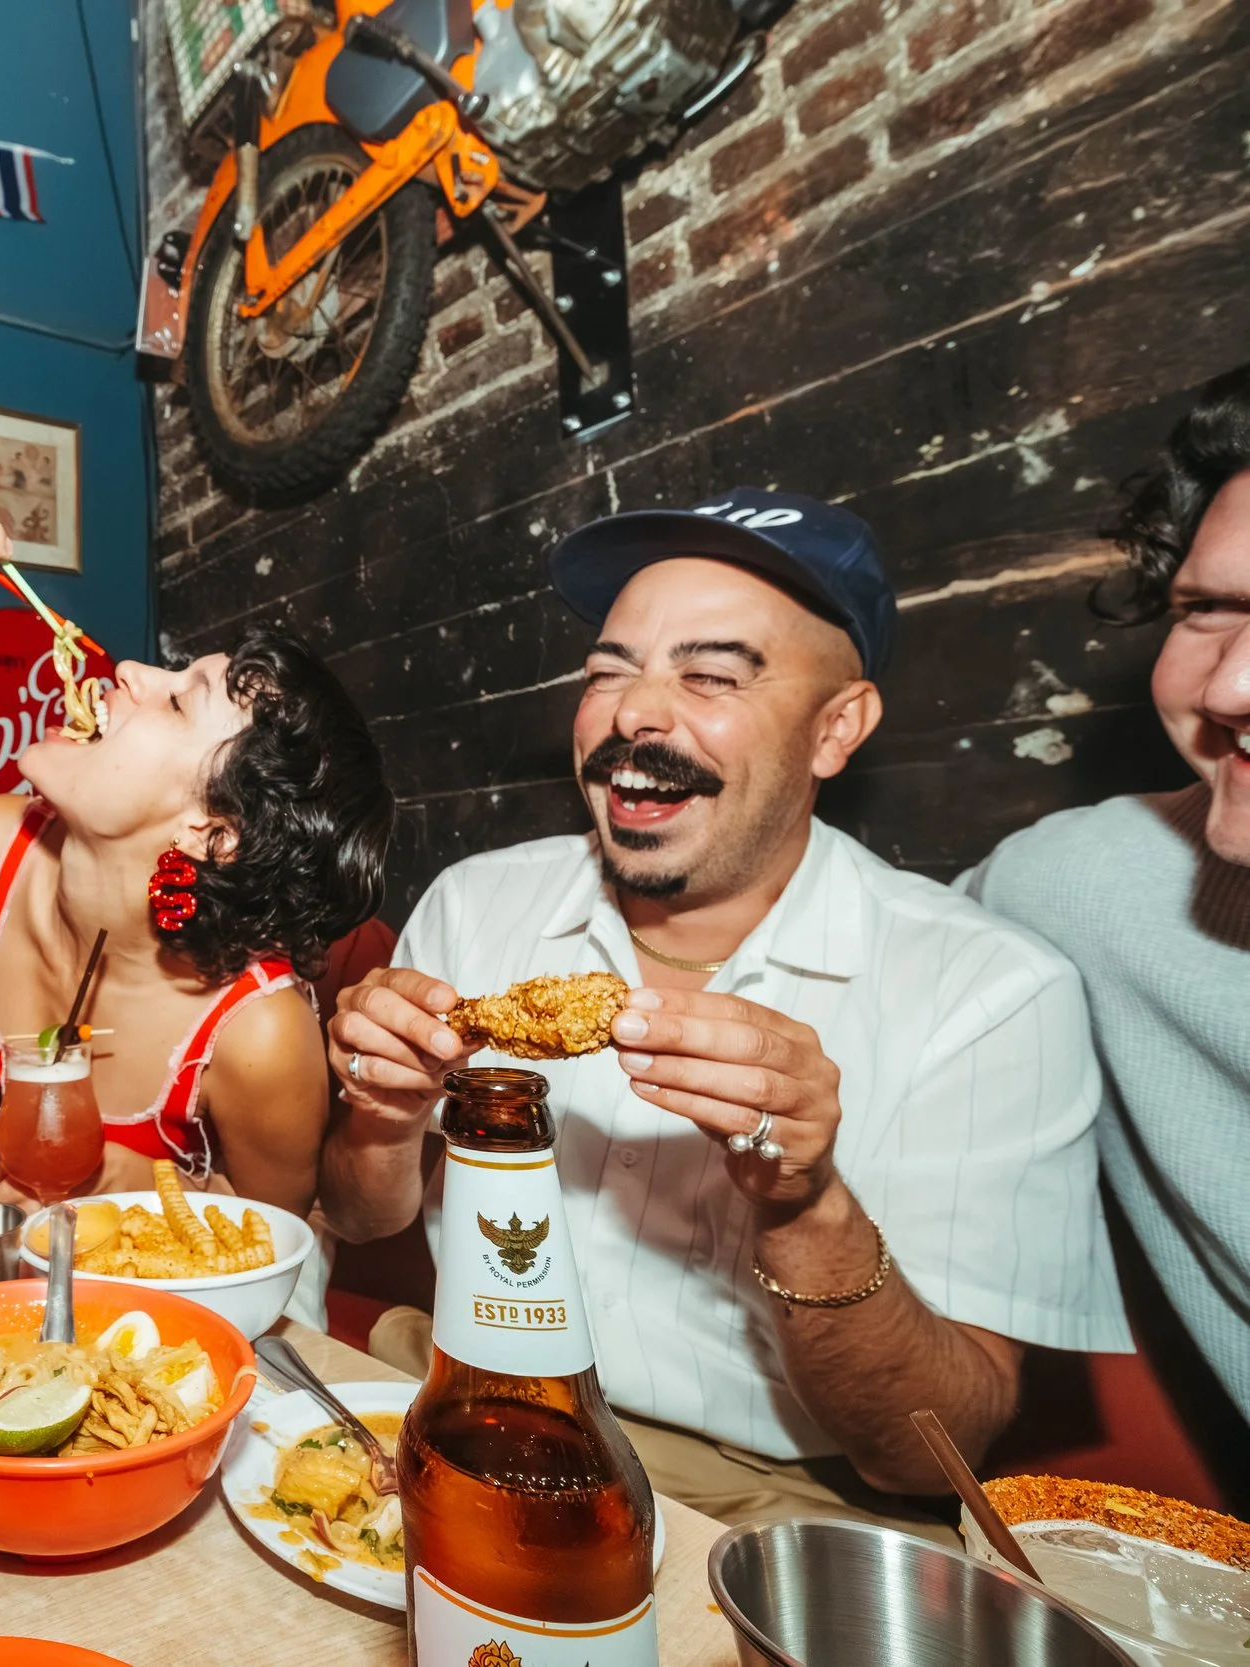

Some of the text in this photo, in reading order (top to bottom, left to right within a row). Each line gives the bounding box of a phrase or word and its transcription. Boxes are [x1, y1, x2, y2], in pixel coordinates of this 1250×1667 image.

[482, 1254, 552, 1288] BY ROYAL PERMISSION
[524, 1307, 567, 1324] 1933
